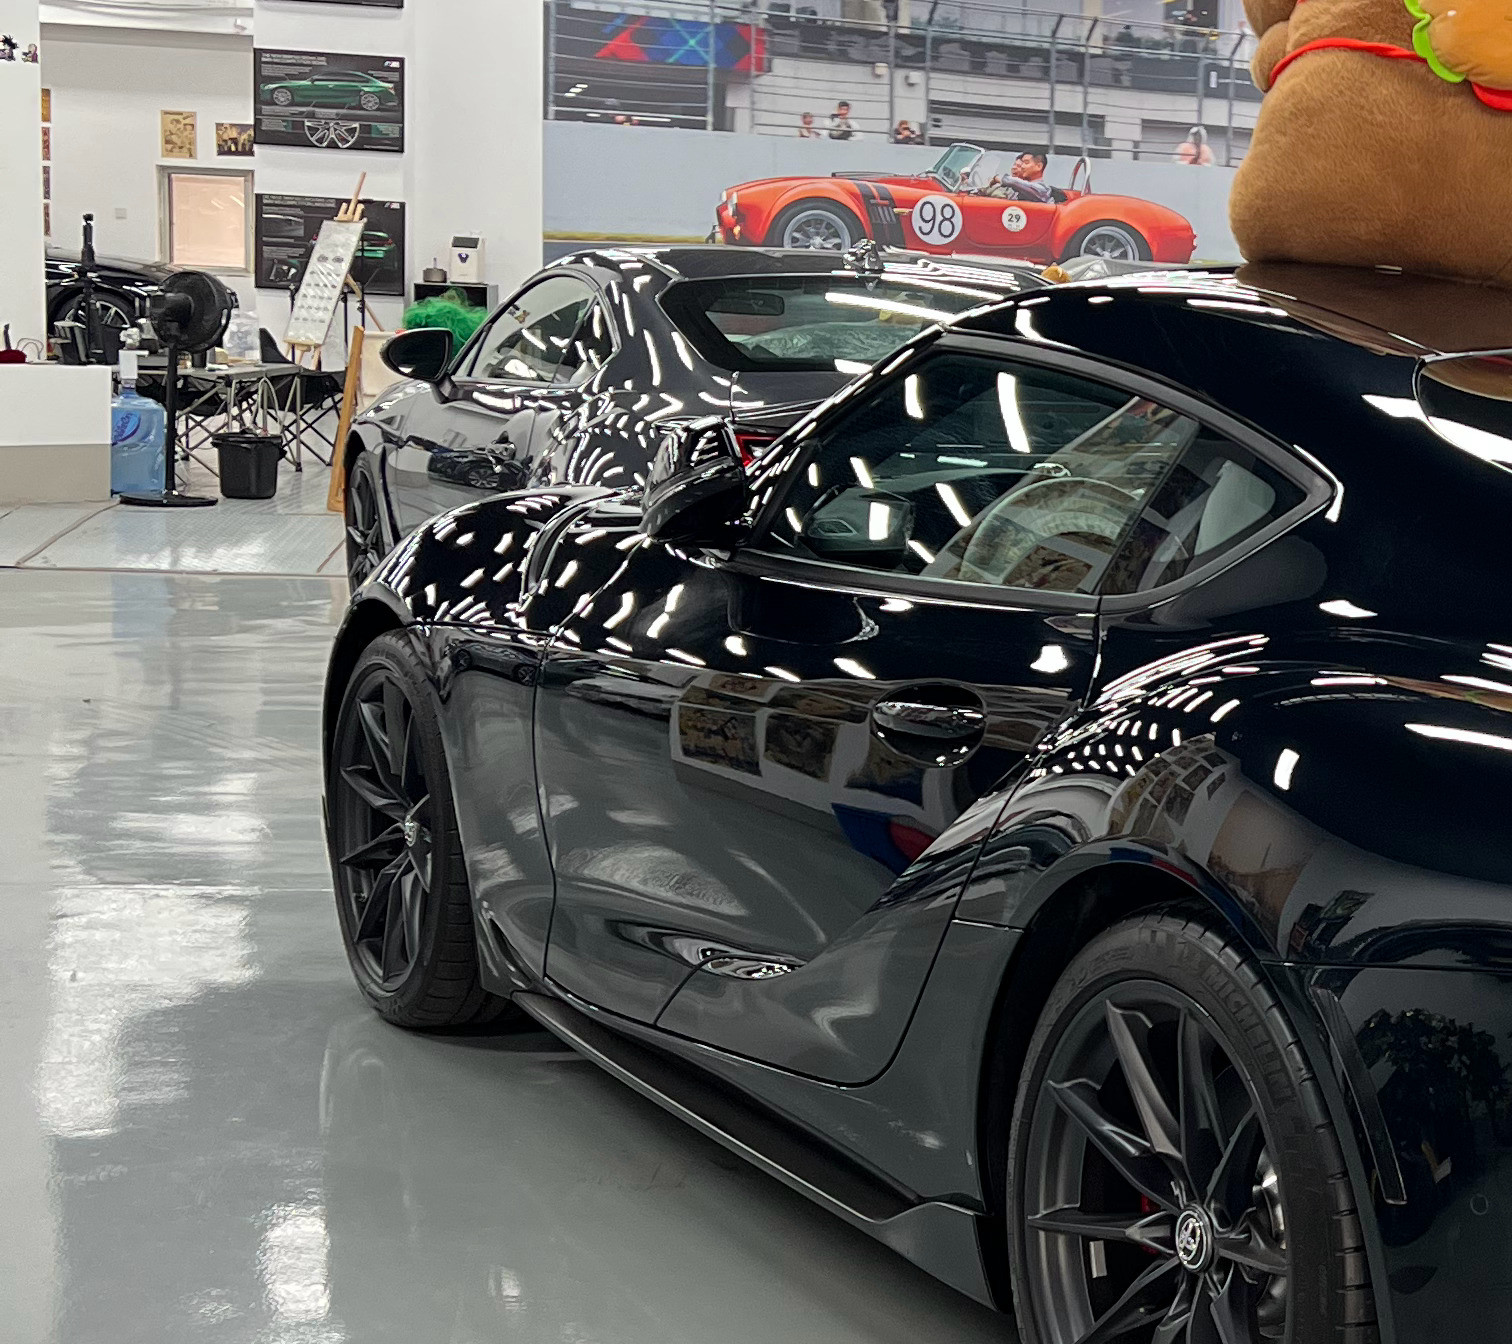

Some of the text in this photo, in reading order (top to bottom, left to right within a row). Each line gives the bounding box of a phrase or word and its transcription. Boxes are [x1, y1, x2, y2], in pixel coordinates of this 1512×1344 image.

[918, 201, 956, 238] 98
[1007, 213, 1021, 223] 29
[1201, 964, 1296, 1108] MICHELIN
